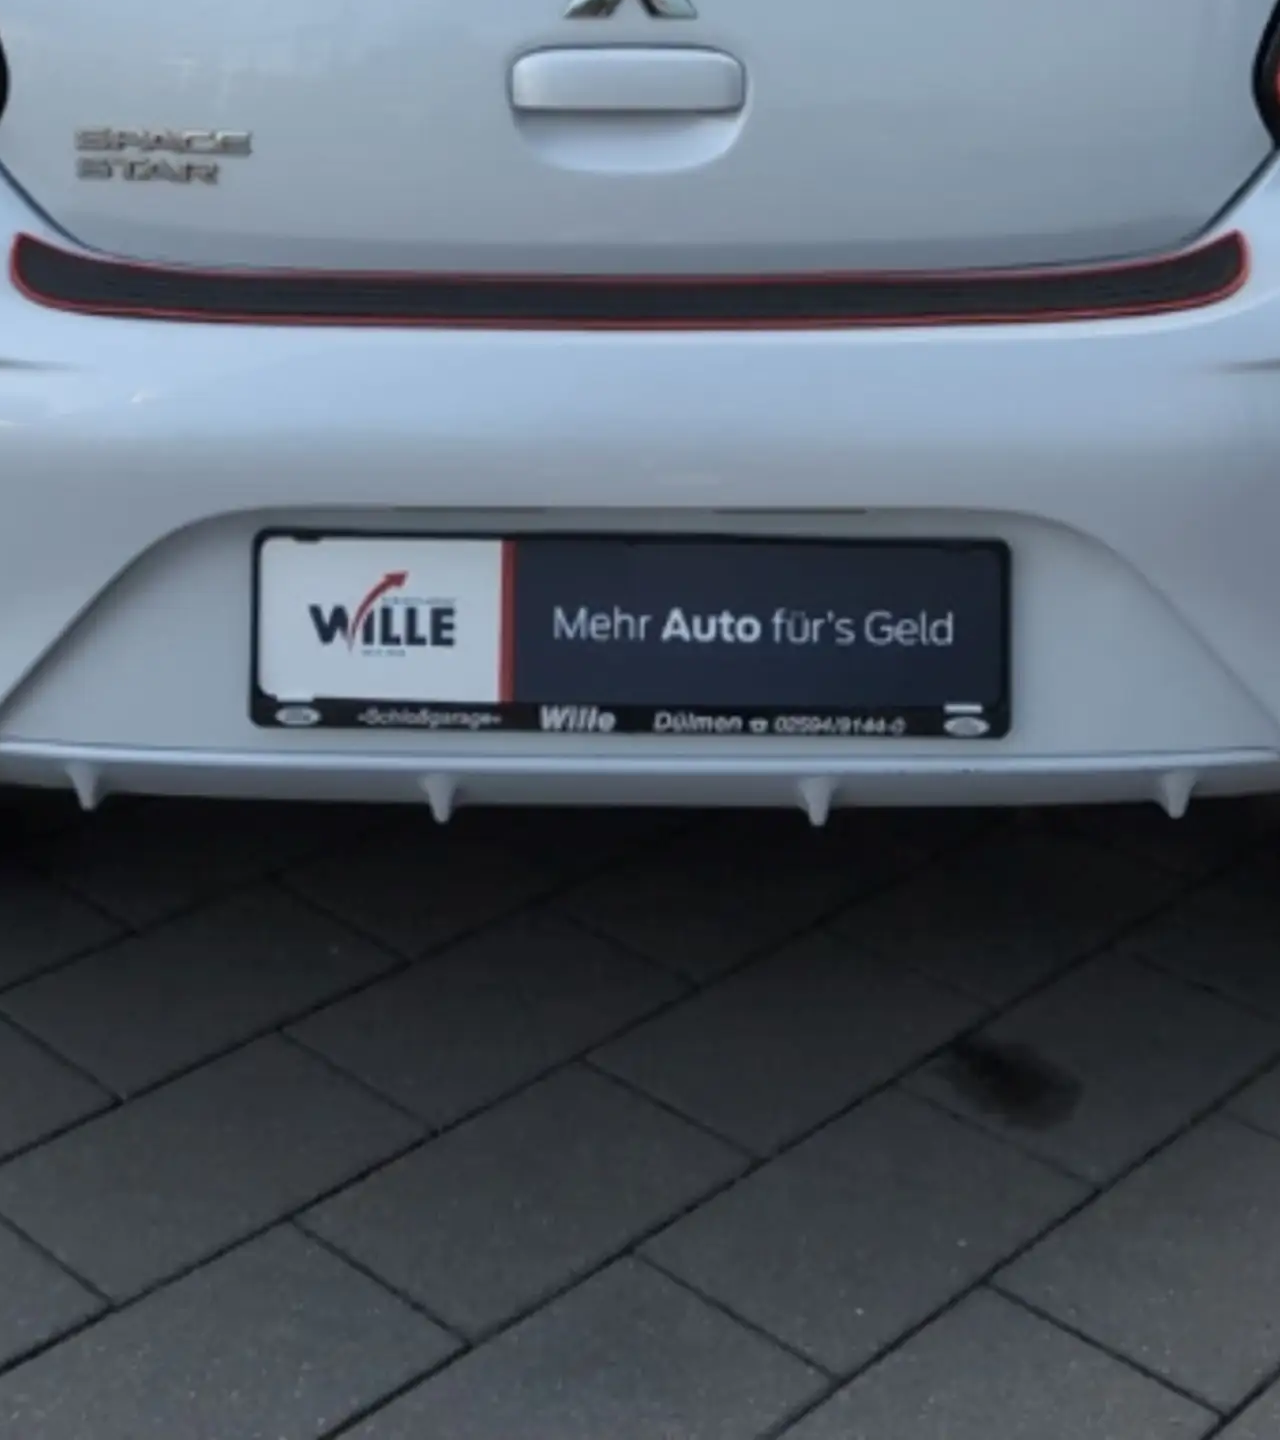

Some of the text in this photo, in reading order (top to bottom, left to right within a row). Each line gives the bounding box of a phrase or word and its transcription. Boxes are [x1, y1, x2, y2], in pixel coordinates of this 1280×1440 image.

[75, 128, 252, 156] SPACE
[75, 158, 220, 184] STAR
[308, 603, 456, 648] WILLE
[552, 606, 954, 647] Mehr Auto für's Geld
[539, 705, 616, 733] Wille
